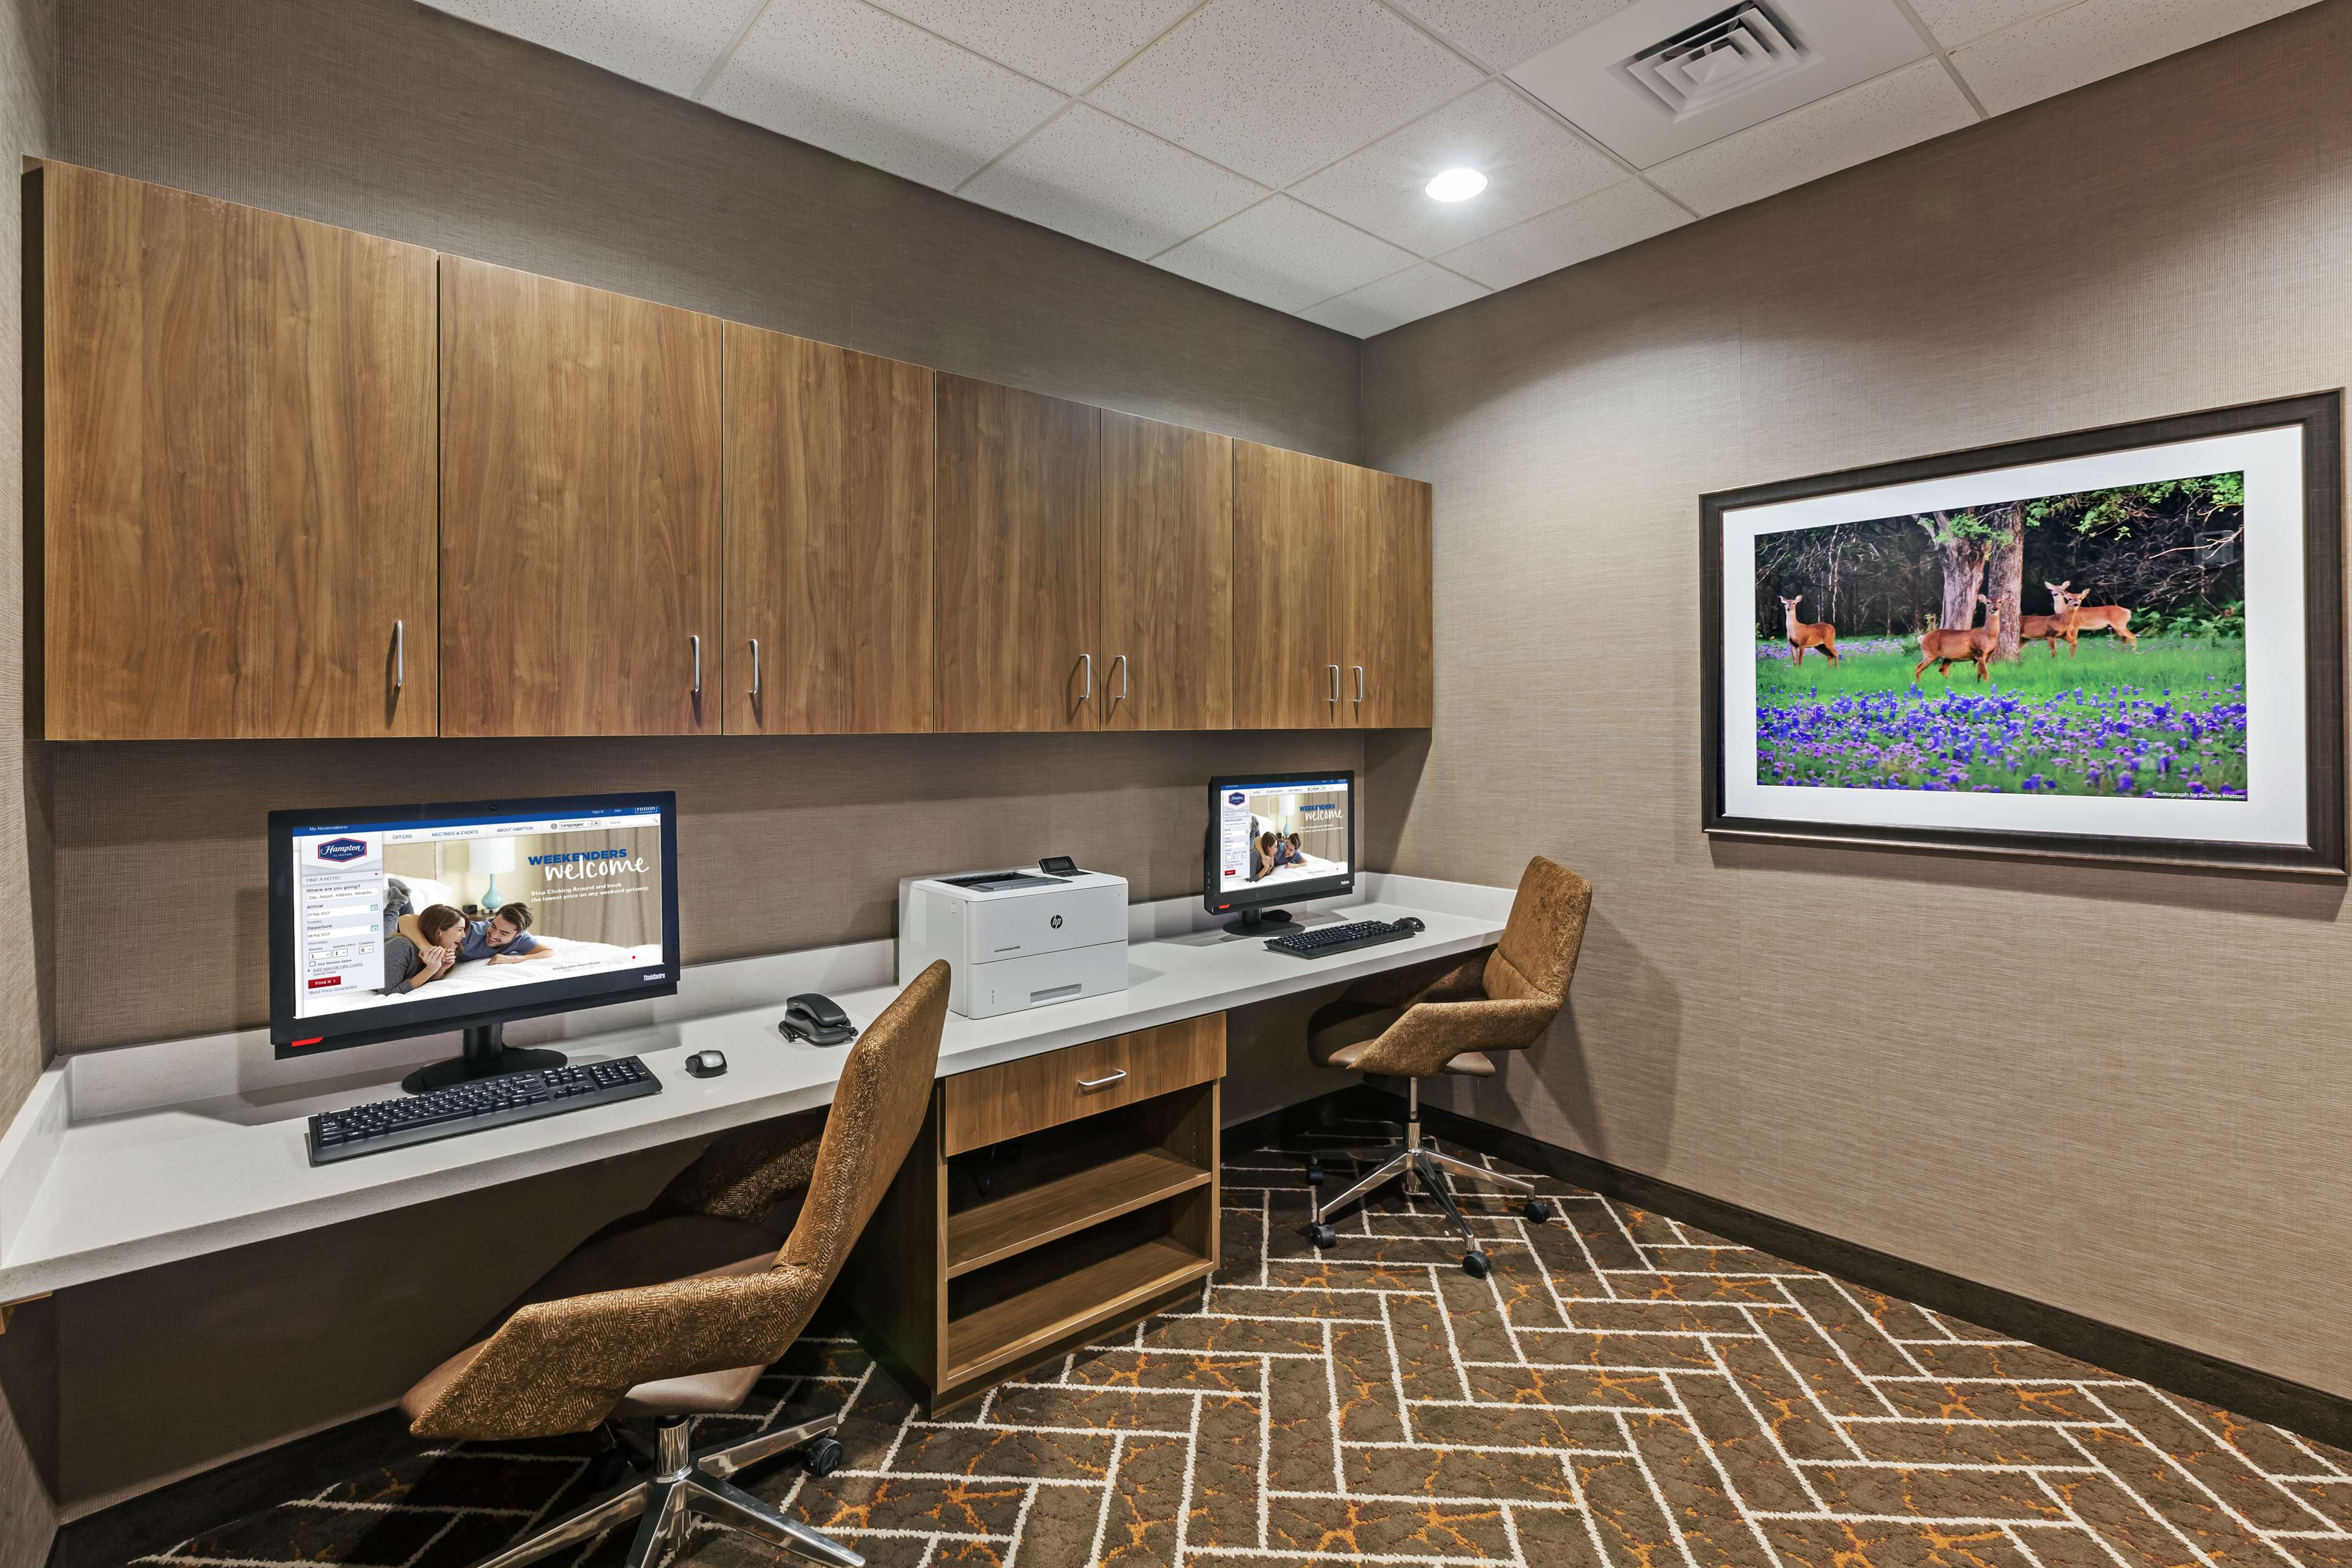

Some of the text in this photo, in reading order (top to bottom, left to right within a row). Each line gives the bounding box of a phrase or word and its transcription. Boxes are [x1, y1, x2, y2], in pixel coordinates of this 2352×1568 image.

[1299, 803, 1335, 812] WEEKENDERS
[1305, 807, 1344, 821] welcome
[320, 845, 364, 855] Hampton
[527, 848, 628, 865] WEEKENDERS
[545, 854, 650, 881] welcome
[1050, 914, 1063, 929] hp
